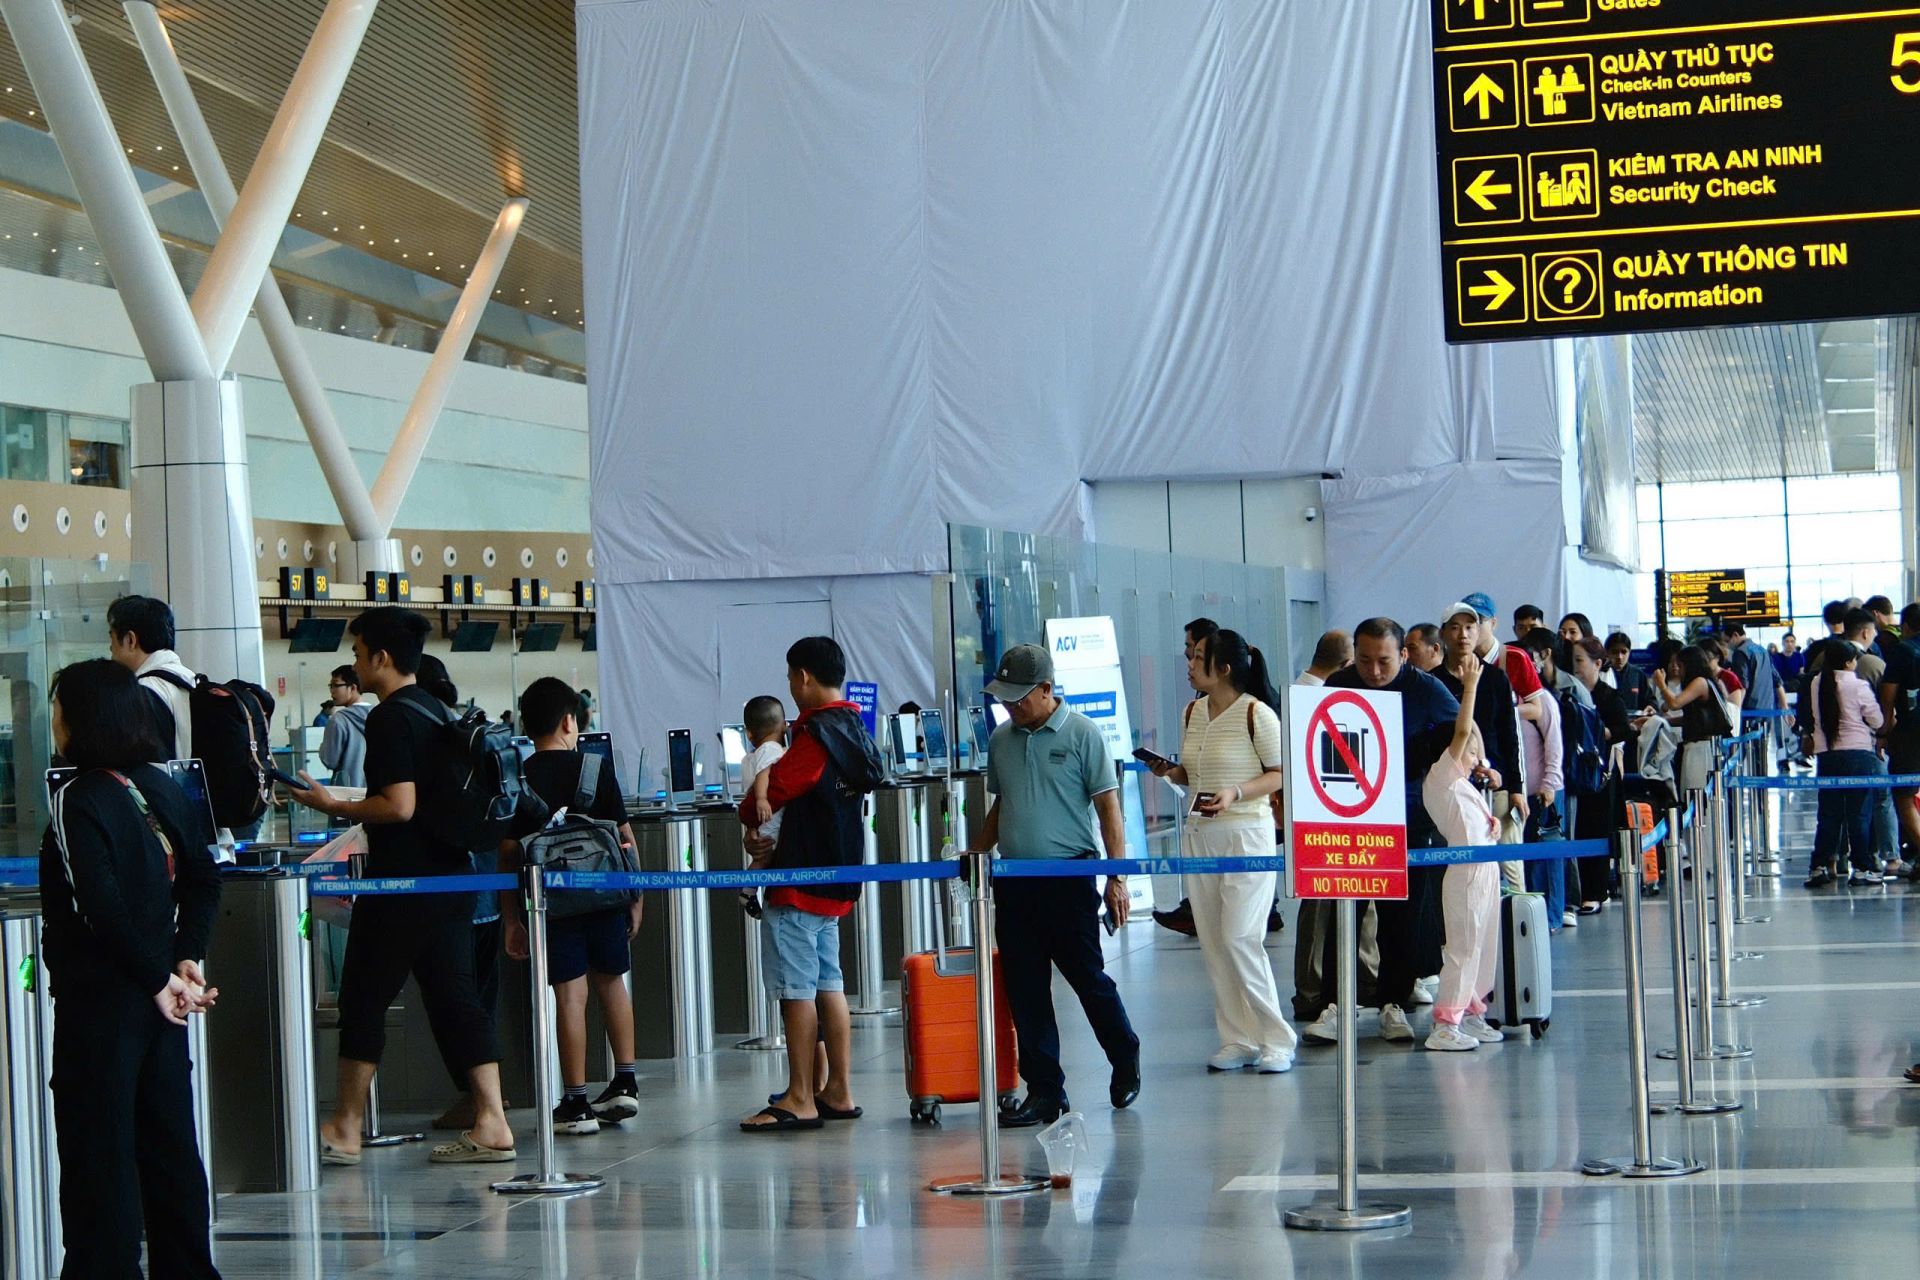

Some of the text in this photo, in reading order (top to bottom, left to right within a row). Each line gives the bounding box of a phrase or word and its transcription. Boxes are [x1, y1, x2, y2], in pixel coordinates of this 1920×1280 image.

[1600, 42, 1774, 75] QUẦY THỦ TỤC
[1601, 71, 1753, 94] Check-in Counters
[1601, 93, 1783, 122] Vietnam Airlines
[1608, 144, 1822, 178] KIỂM TRA AN NINH
[1609, 175, 1777, 204] Security Check
[1612, 242, 1848, 280] QUẦY THÔNG TIN
[1614, 283, 1763, 312] Information
[292, 575, 302, 591] 57
[316, 575, 327, 592] 58
[377, 578, 387, 594] 59
[400, 579, 409, 595] 60
[454, 582, 462, 597] 61
[1056, 635, 1077, 651] ACV
[1304, 832, 1394, 847] KHÔNG DÙNG
[1326, 853, 1344, 865] XE
[1423, 849, 1474, 862] AIRPORT
[299, 864, 335, 875] AIRPORT
[1136, 860, 1171, 873] TIA
[1243, 859, 1285, 870] TAN SO
[314, 879, 416, 892] INTERNATIONAL AIRPORT
[629, 870, 837, 886] TAN SON NHAT INTERNATIONAL AIRPORT
[1313, 877, 1388, 894] NO TROLLEY
